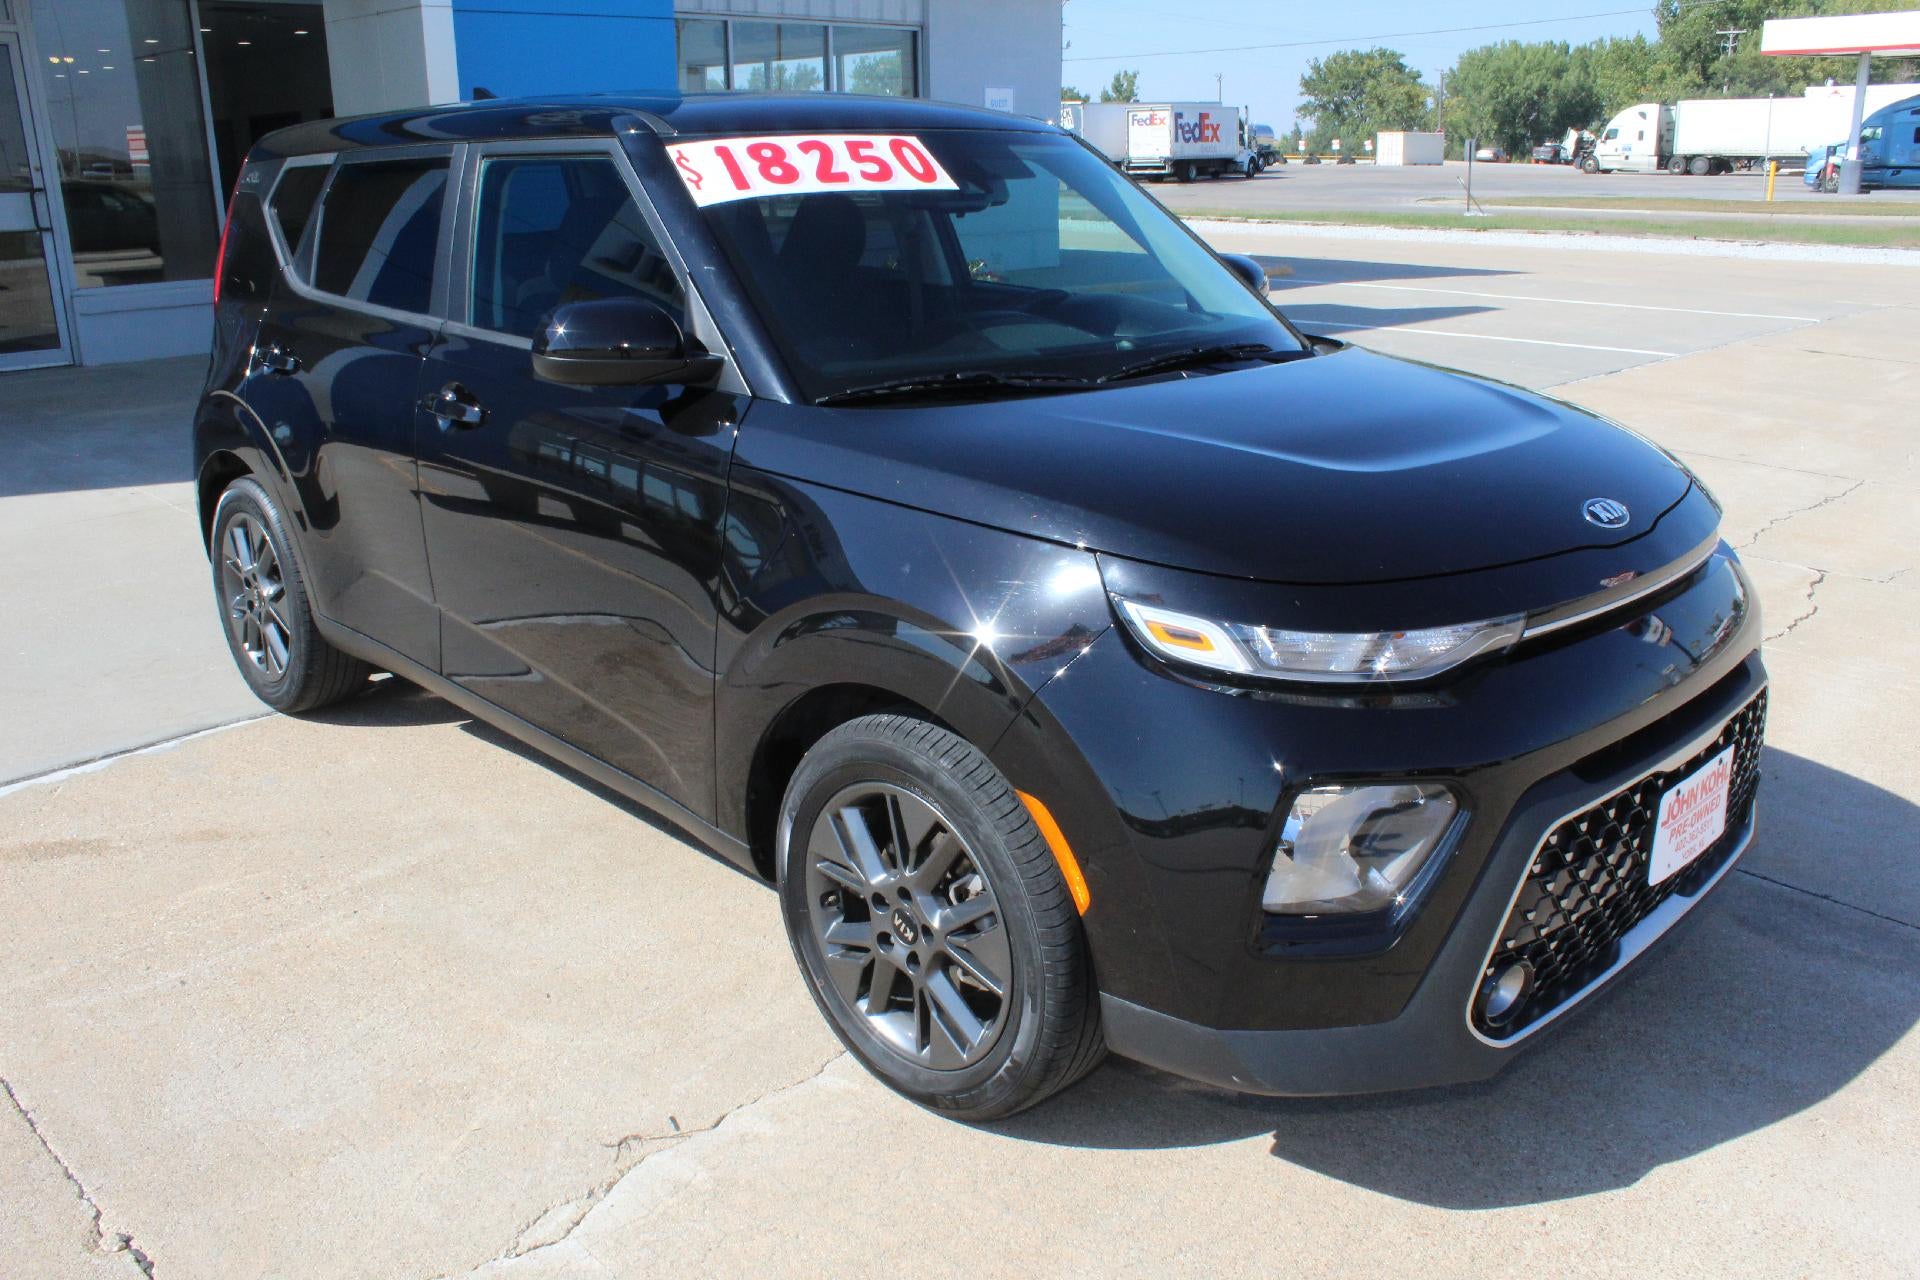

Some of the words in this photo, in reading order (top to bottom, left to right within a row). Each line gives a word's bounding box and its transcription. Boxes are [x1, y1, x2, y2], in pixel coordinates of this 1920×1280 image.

[1131, 111, 1167, 127] FedEx
[1174, 111, 1221, 144] FedEx
[1661, 783, 1700, 828] JOHN
[1700, 763, 1730, 796] KOHL
[1669, 795, 1721, 842] PRE-OWNED
[894, 912, 915, 942] KIA
